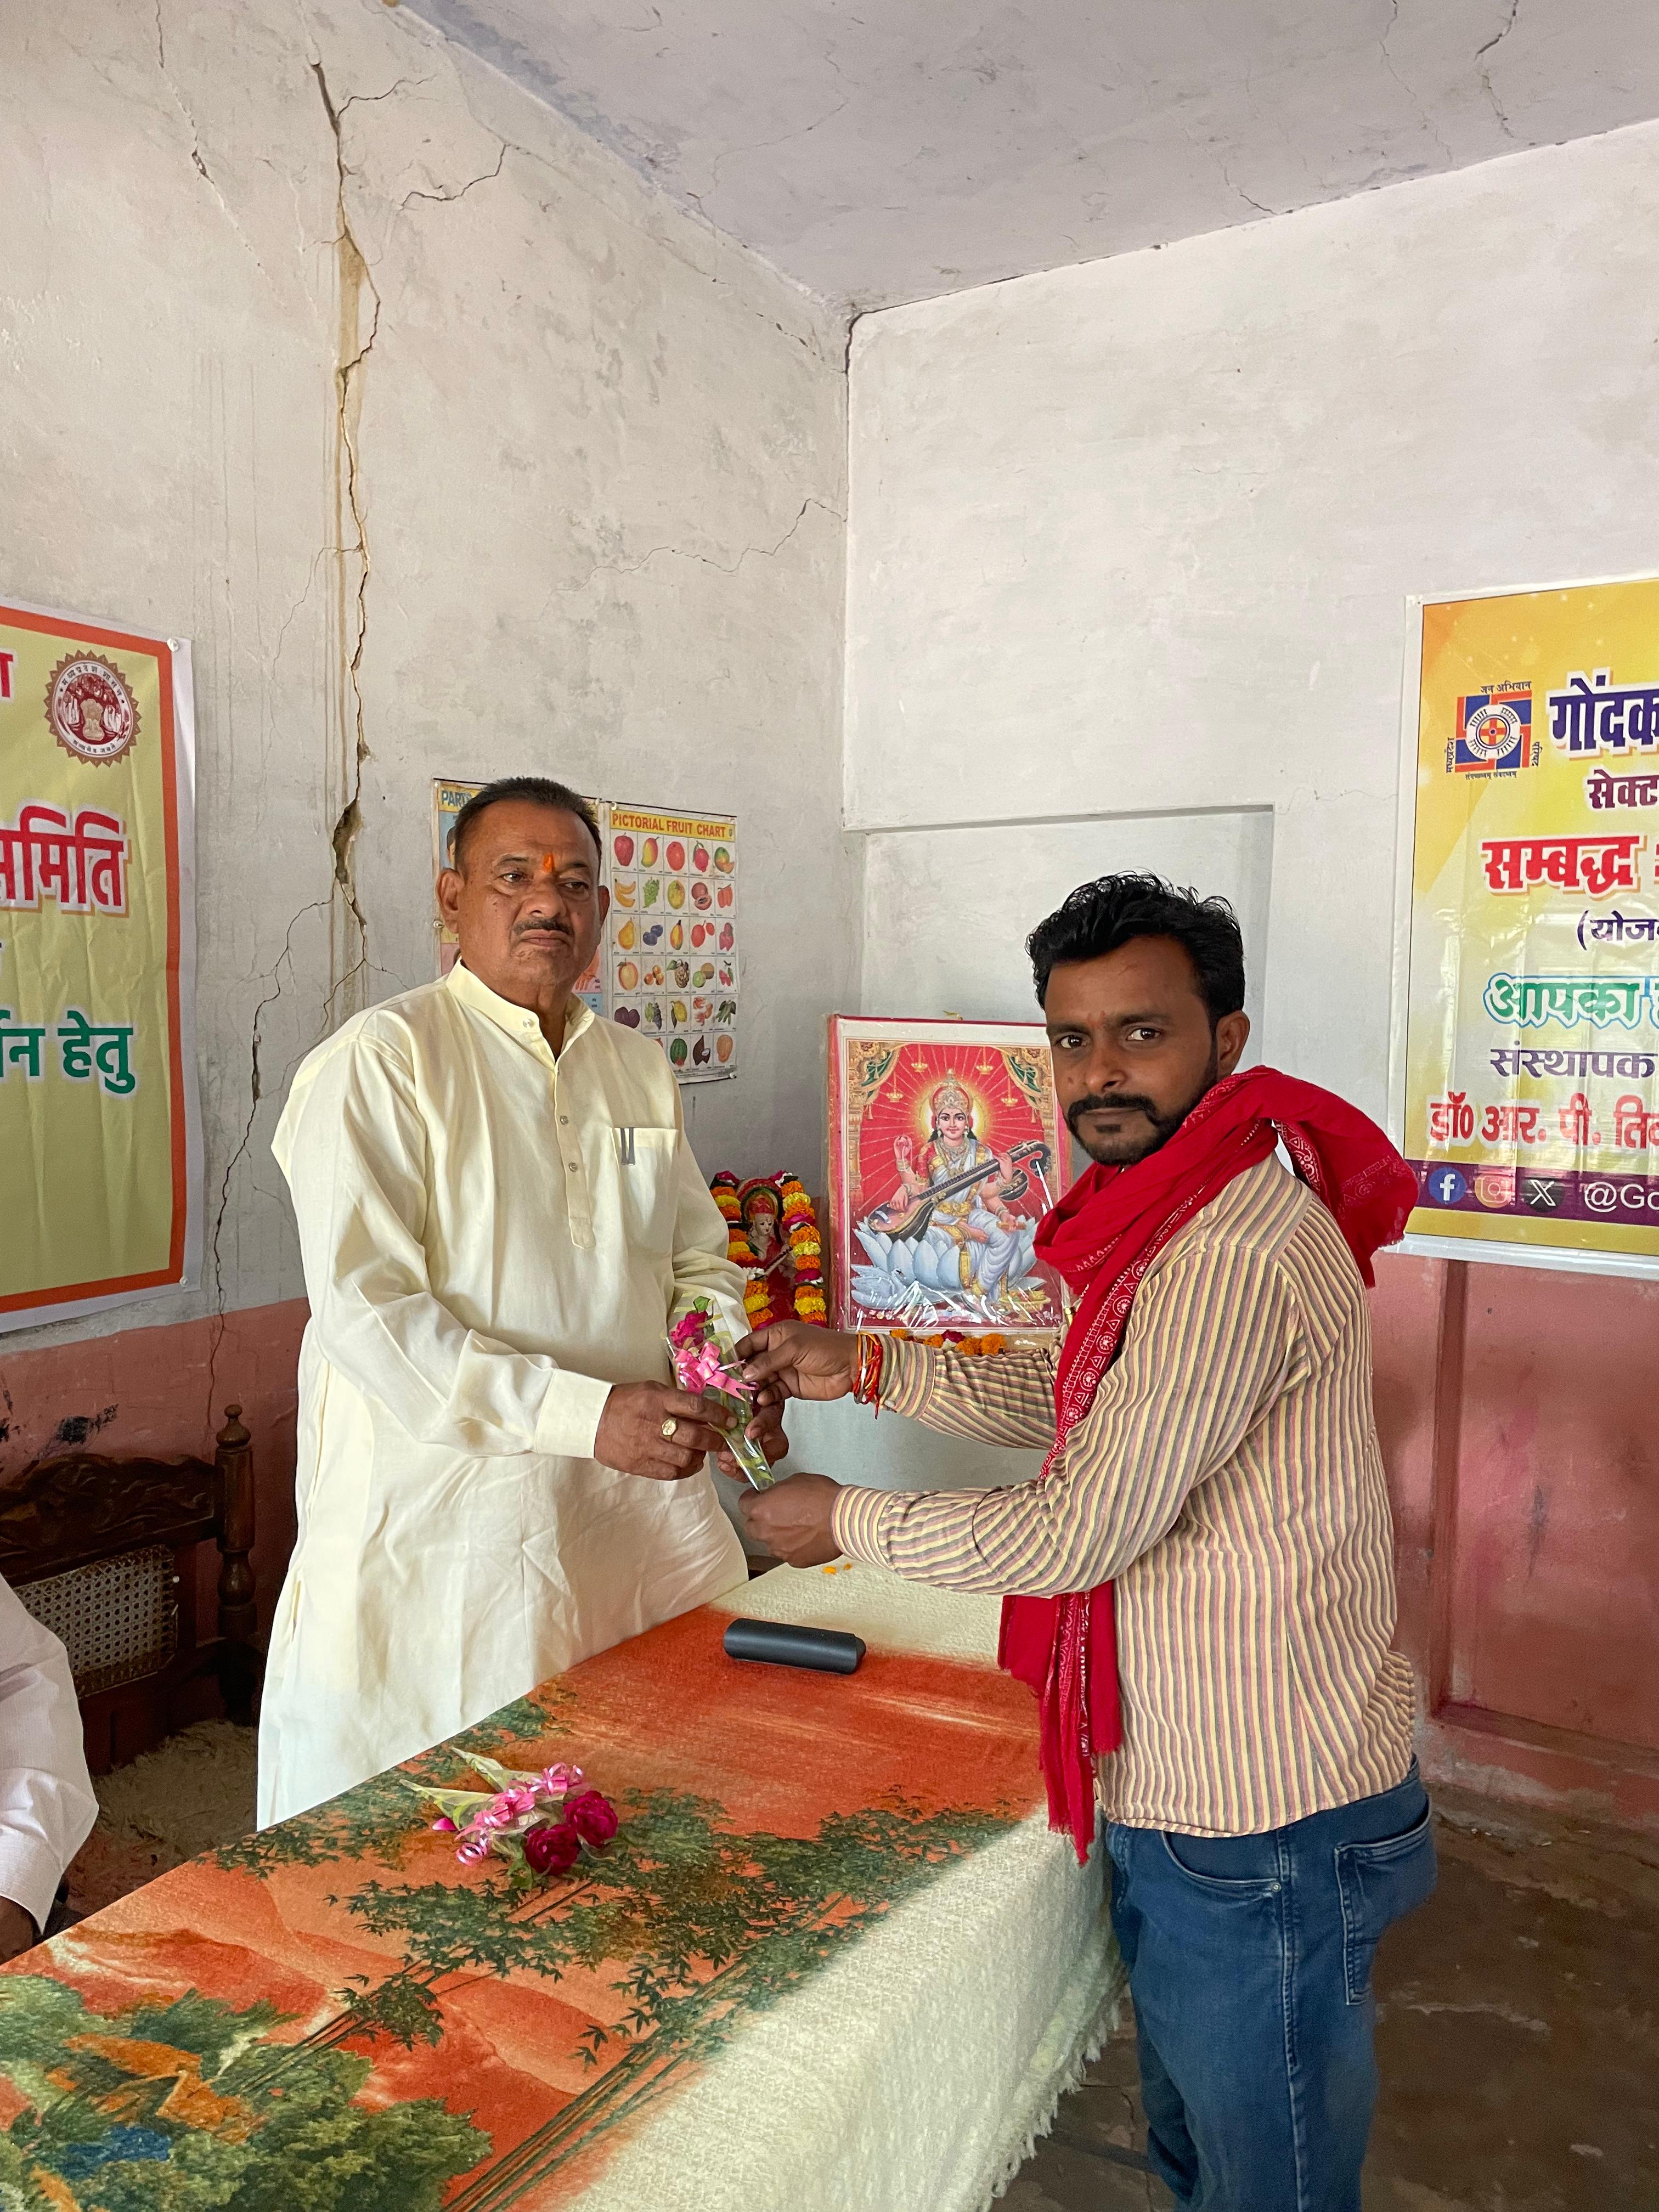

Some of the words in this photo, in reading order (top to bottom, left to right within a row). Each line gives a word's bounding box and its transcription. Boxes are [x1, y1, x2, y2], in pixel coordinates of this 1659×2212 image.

[1481, 685, 1494, 694] जन
[1497, 680, 1532, 693] अभियान
[612, 814, 664, 831] PICTORIAL
[667, 820, 692, 834] FRUIT
[697, 824, 726, 838] CHART
[1482, 836, 1640, 894] सम्बद्ध
[1577, 910, 1659, 951] (योज
[1489, 979, 1640, 1022] आपका
[58, 1010, 136, 1094] हेतु
[1490, 1040, 1658, 1078] संस्थापक
